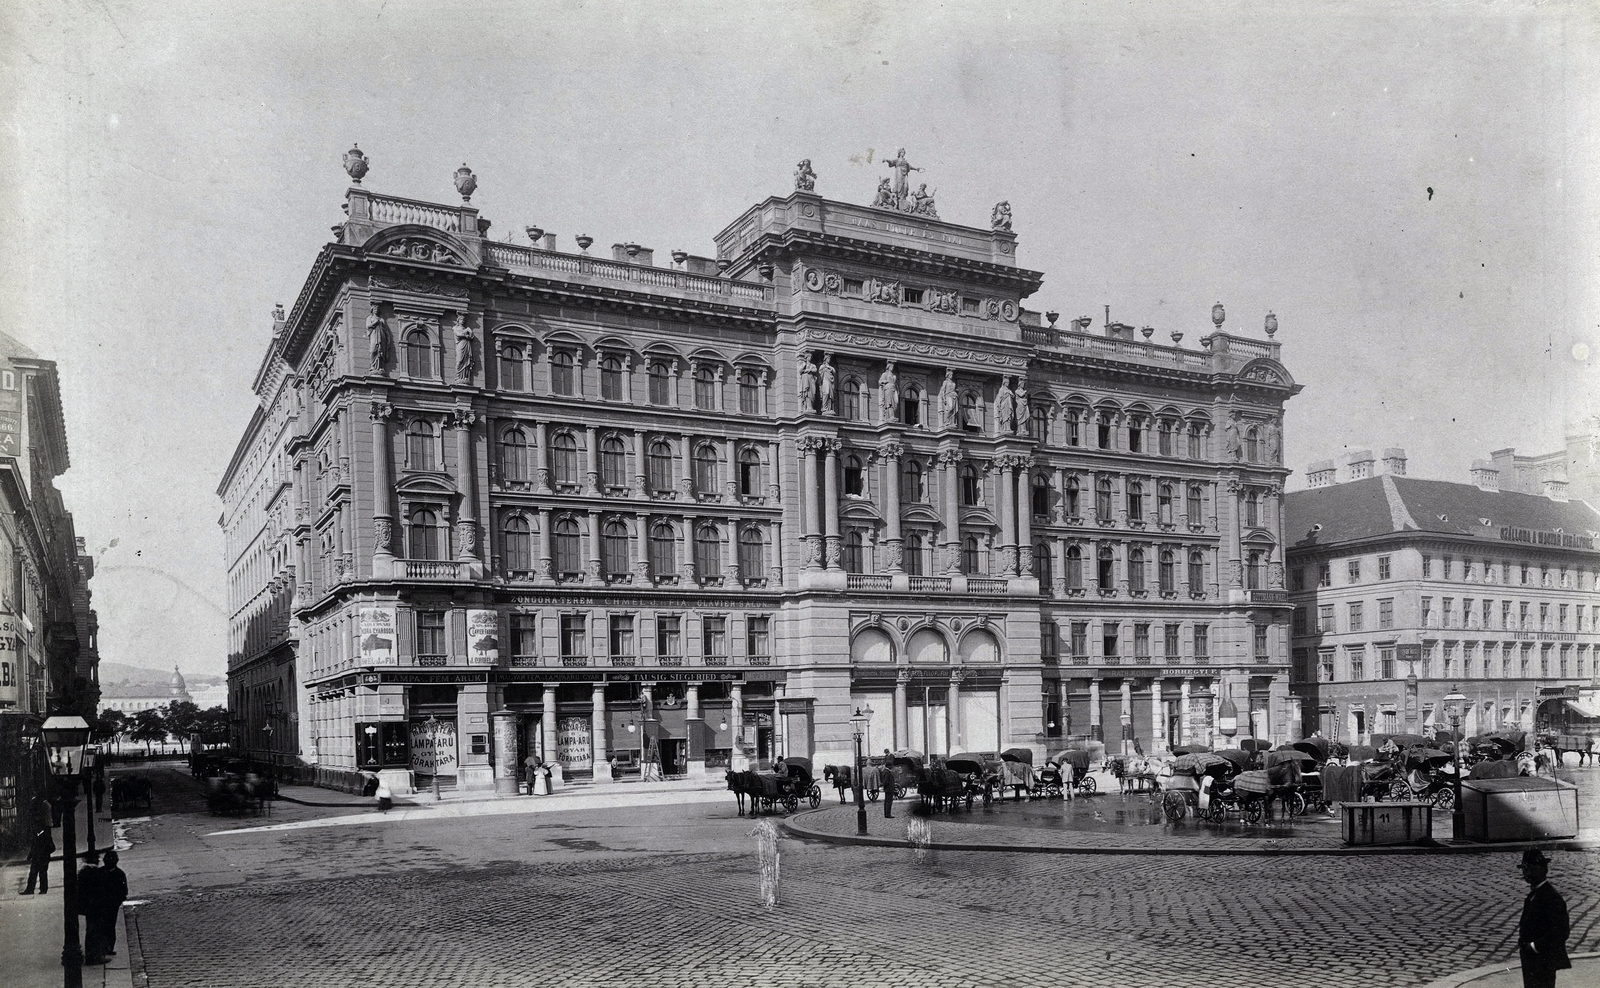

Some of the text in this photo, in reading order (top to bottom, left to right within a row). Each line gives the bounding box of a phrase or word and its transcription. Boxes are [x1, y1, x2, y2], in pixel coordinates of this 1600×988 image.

[604, 598, 646, 606] CHMEL
[633, 672, 717, 681] TAUSIG SIEGFRIED
[1379, 813, 1390, 823] 11
